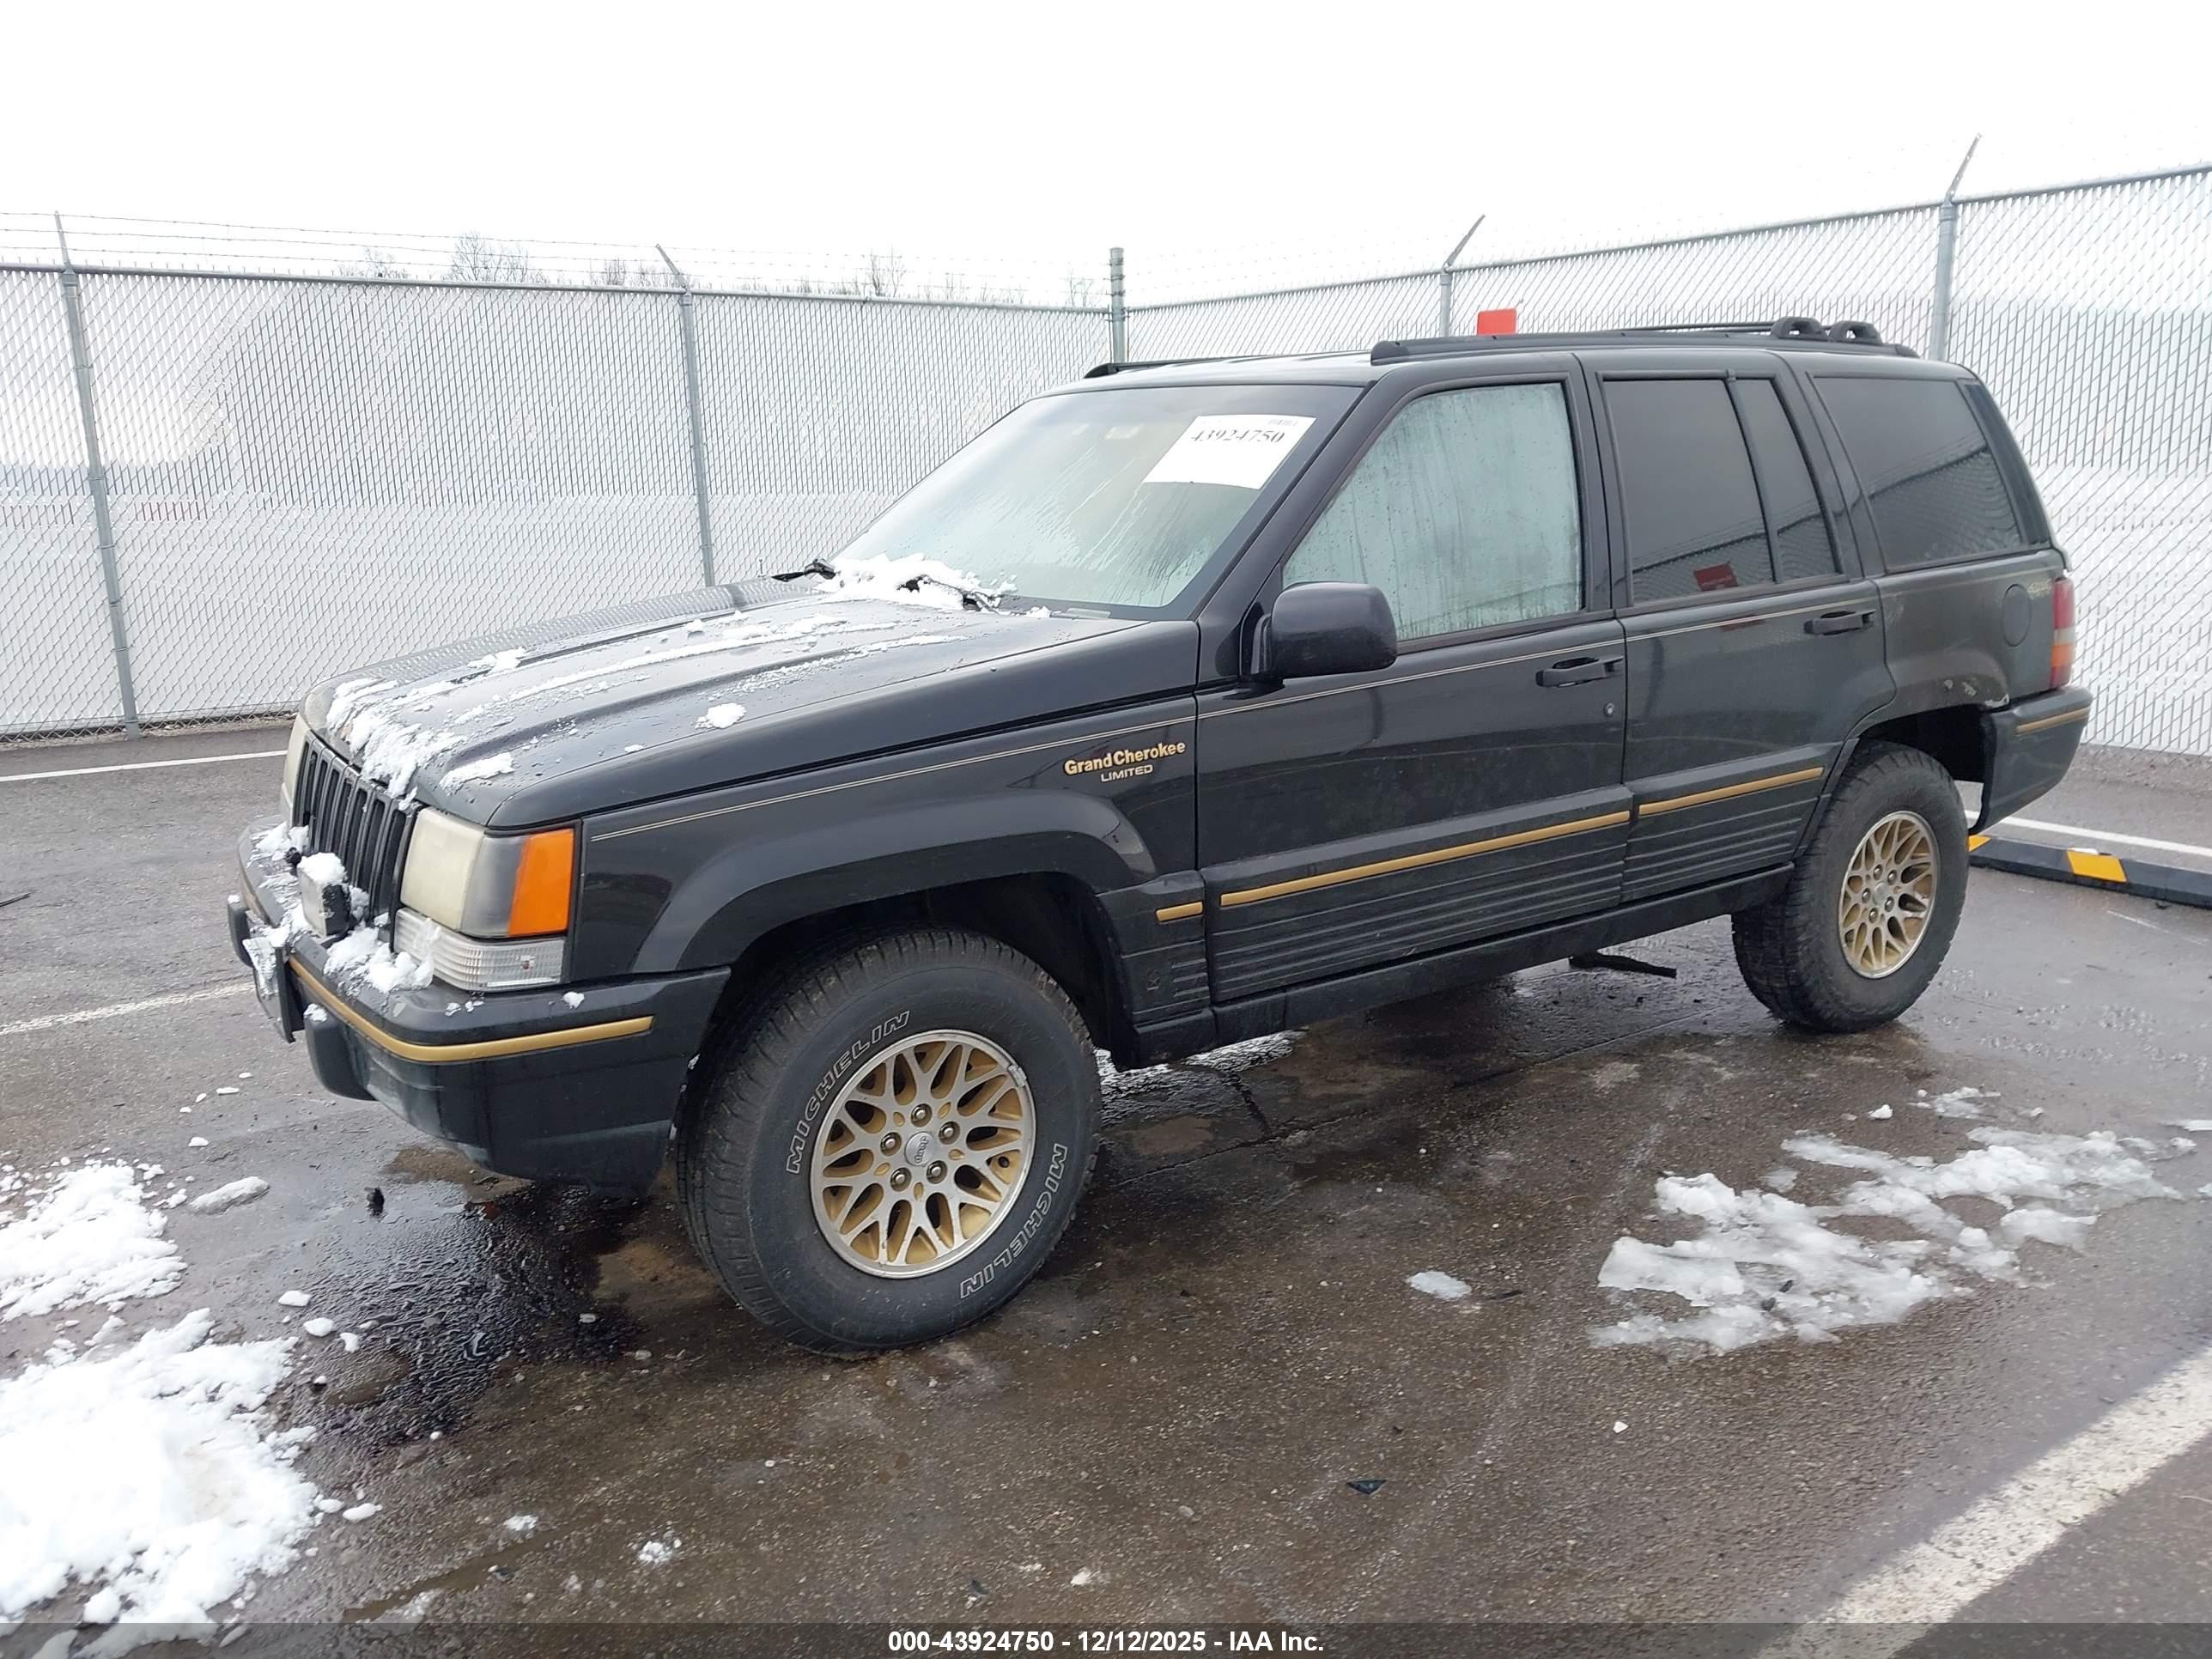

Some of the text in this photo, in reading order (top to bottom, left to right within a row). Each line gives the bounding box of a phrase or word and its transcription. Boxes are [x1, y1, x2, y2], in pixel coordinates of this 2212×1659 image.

[1191, 429, 1286, 444] 43924750
[1100, 764, 1154, 782] LIMITED
[786, 1010, 910, 1175] MICHELIN
[959, 1143, 1067, 1299] MICHELIN
